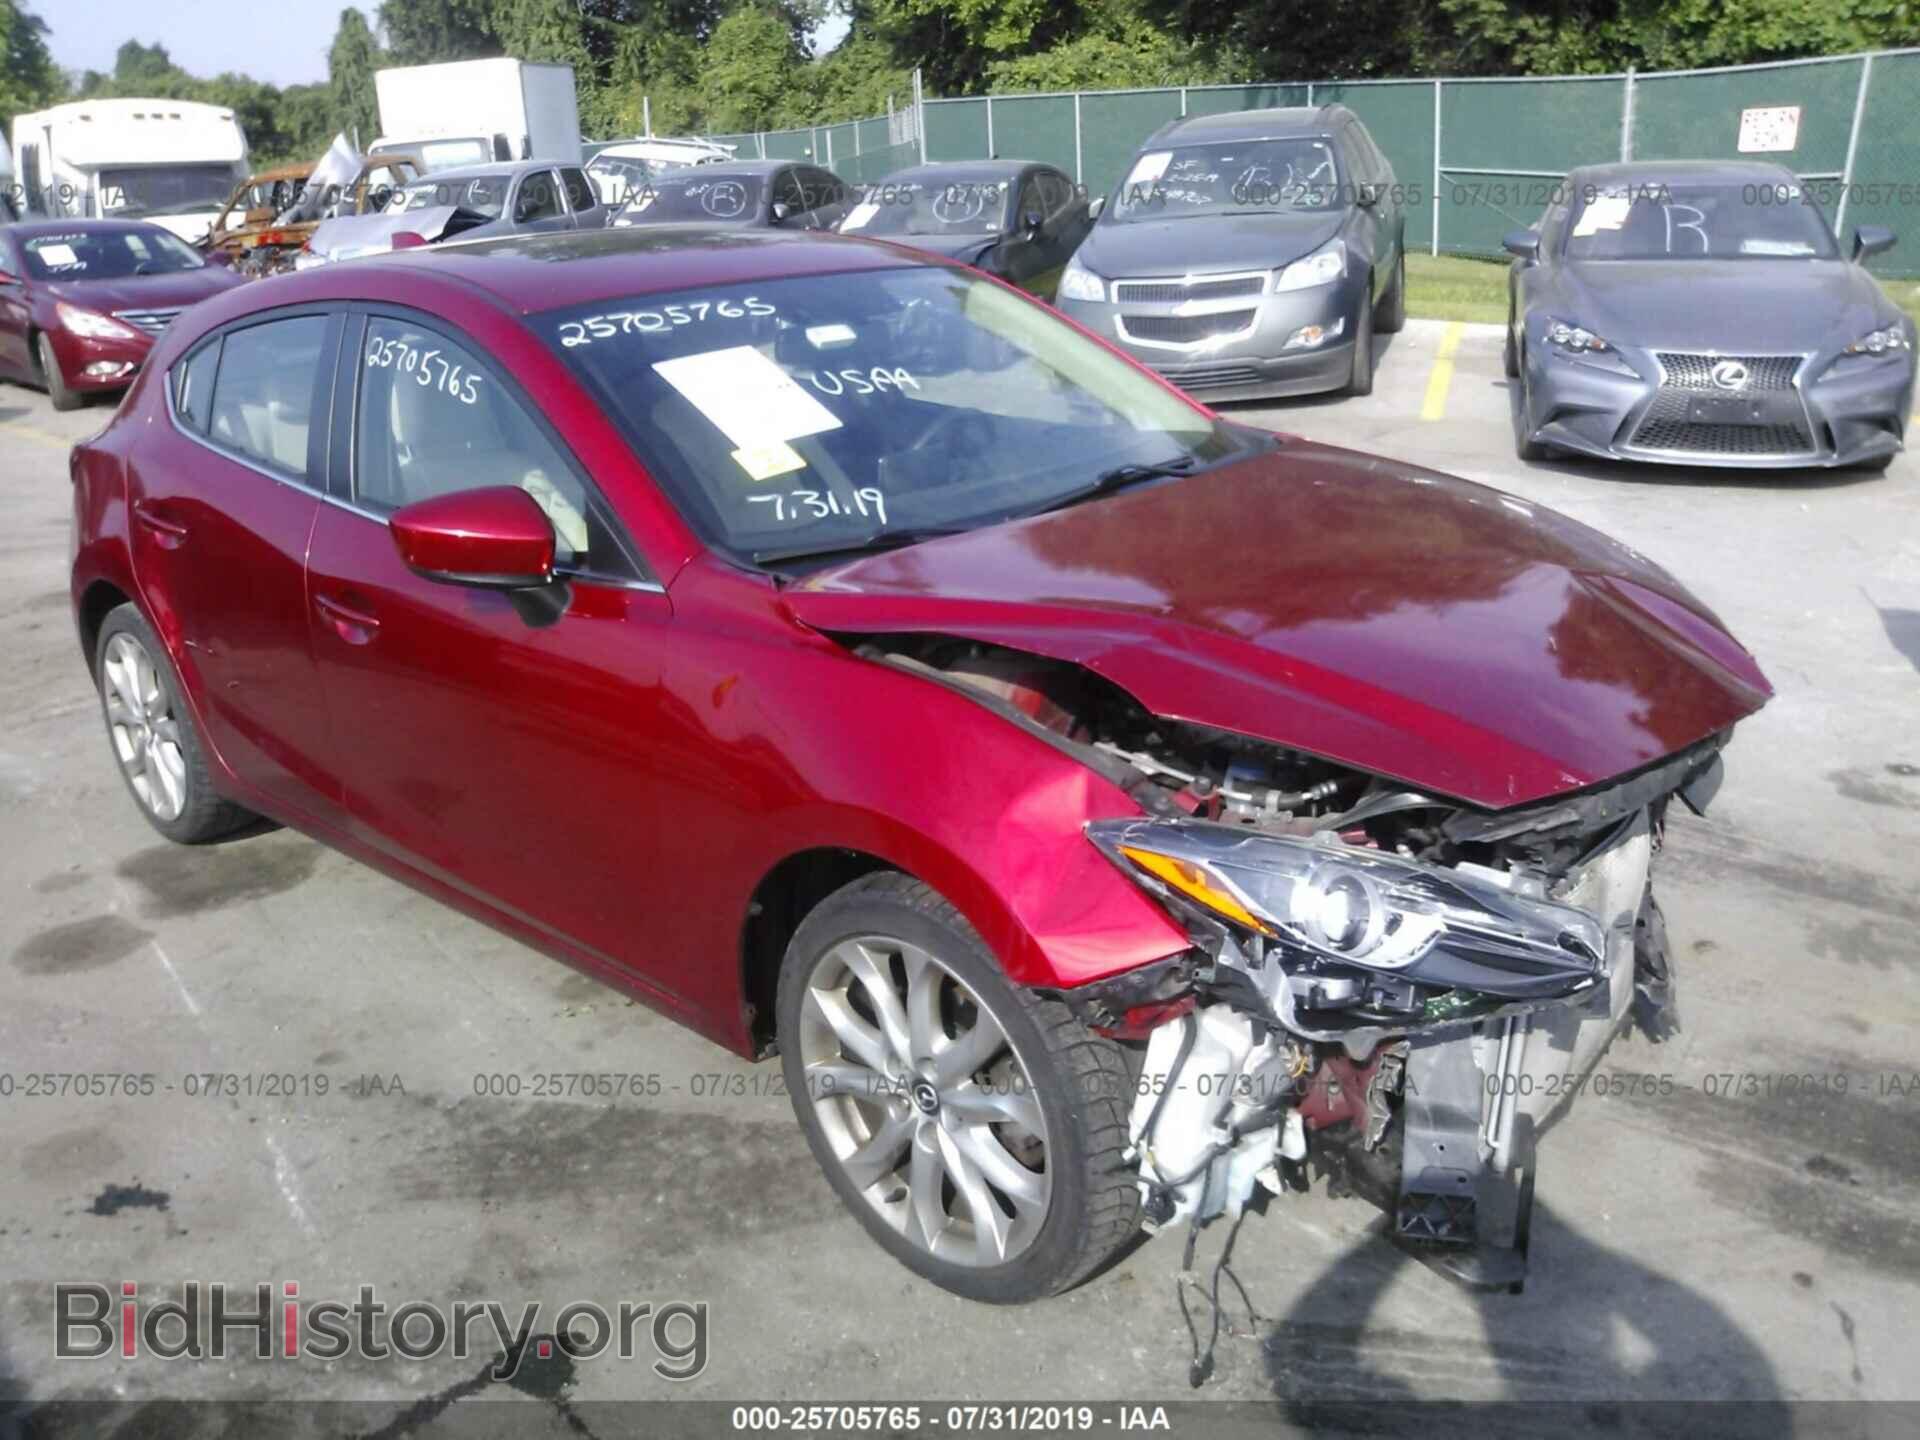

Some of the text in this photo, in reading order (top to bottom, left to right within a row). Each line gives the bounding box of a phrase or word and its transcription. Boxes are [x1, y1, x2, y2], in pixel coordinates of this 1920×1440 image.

[1662, 203, 1709, 254] R
[559, 298, 776, 347] 25705765
[367, 336, 482, 404] 25705765
[811, 367, 921, 395] USAA
